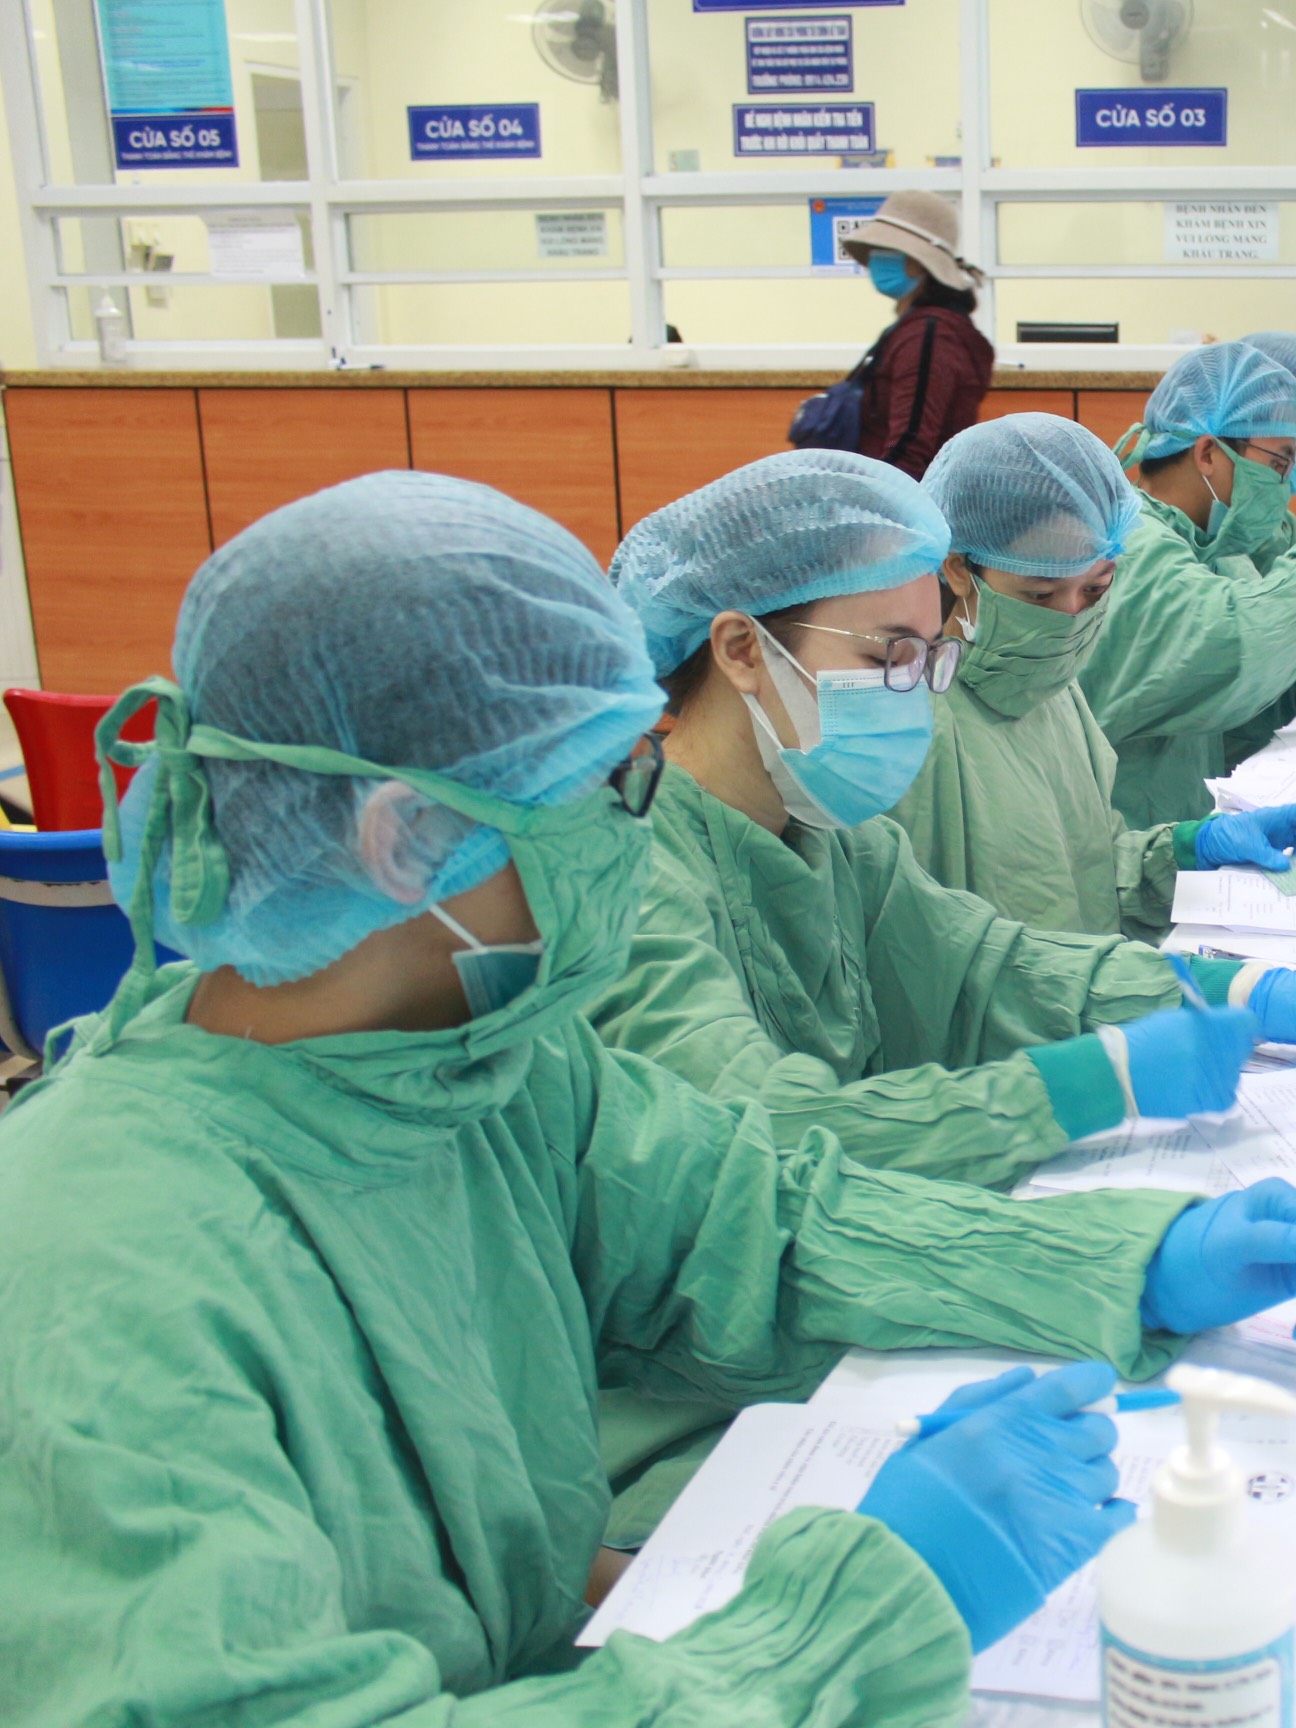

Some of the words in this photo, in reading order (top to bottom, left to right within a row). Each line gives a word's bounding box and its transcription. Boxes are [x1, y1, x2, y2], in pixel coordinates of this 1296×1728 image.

[425, 115, 466, 138] CỬA
[468, 113, 496, 137] SỐ
[498, 118, 523, 137] 04
[1095, 104, 1141, 127] CỬA
[1145, 102, 1176, 127] SỐ
[1179, 109, 1206, 127] 03
[129, 125, 168, 148] CỬA
[170, 124, 195, 147] SỐ
[198, 129, 221, 146] 05
